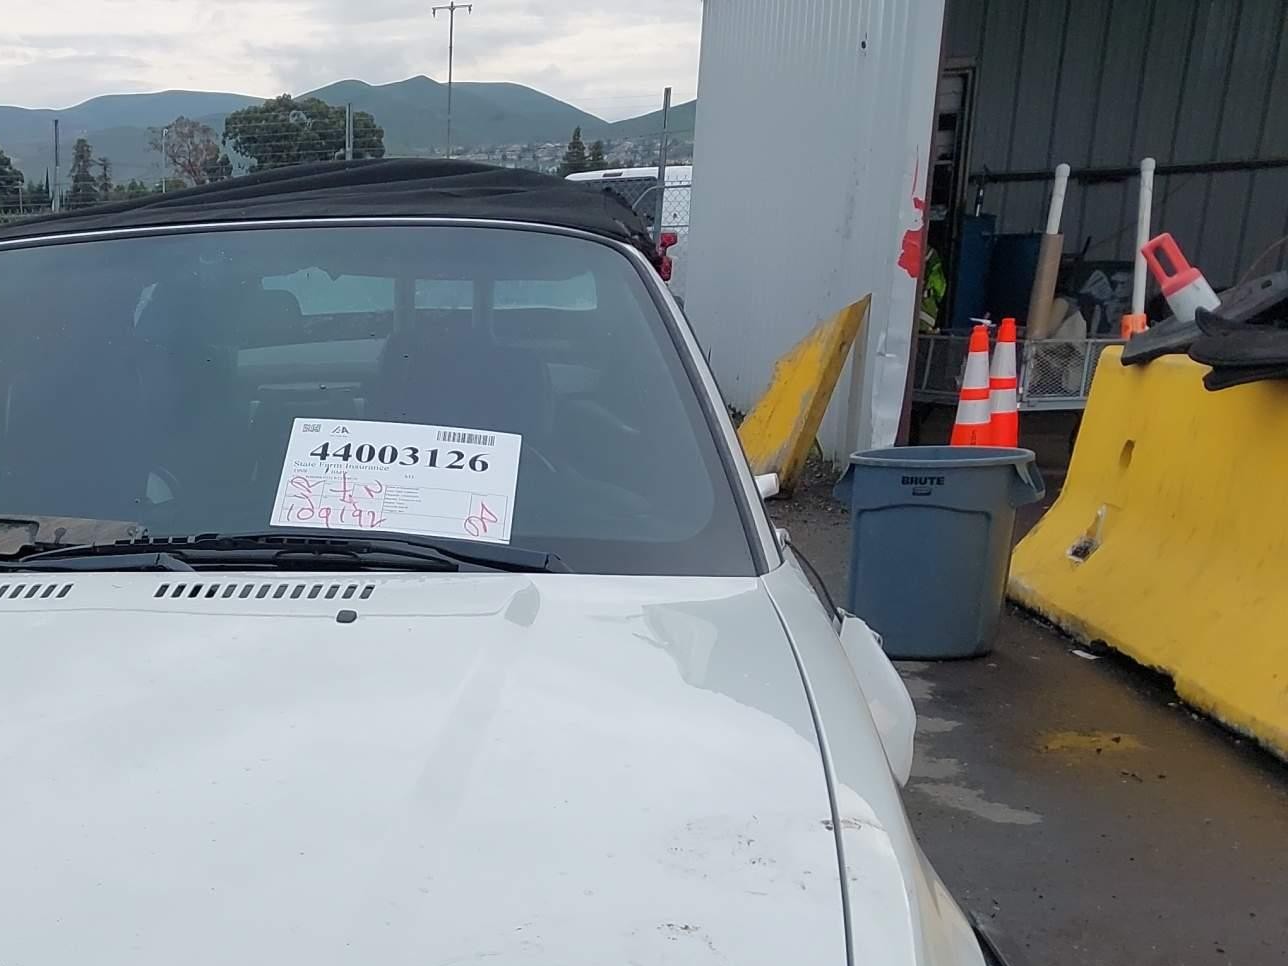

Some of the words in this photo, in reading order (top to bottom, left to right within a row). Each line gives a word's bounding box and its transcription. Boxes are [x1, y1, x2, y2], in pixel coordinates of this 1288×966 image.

[309, 441, 490, 473] 44003126
[294, 460, 317, 468] State
[345, 463, 390, 472] Insurance
[901, 475, 945, 486] BRUTE
